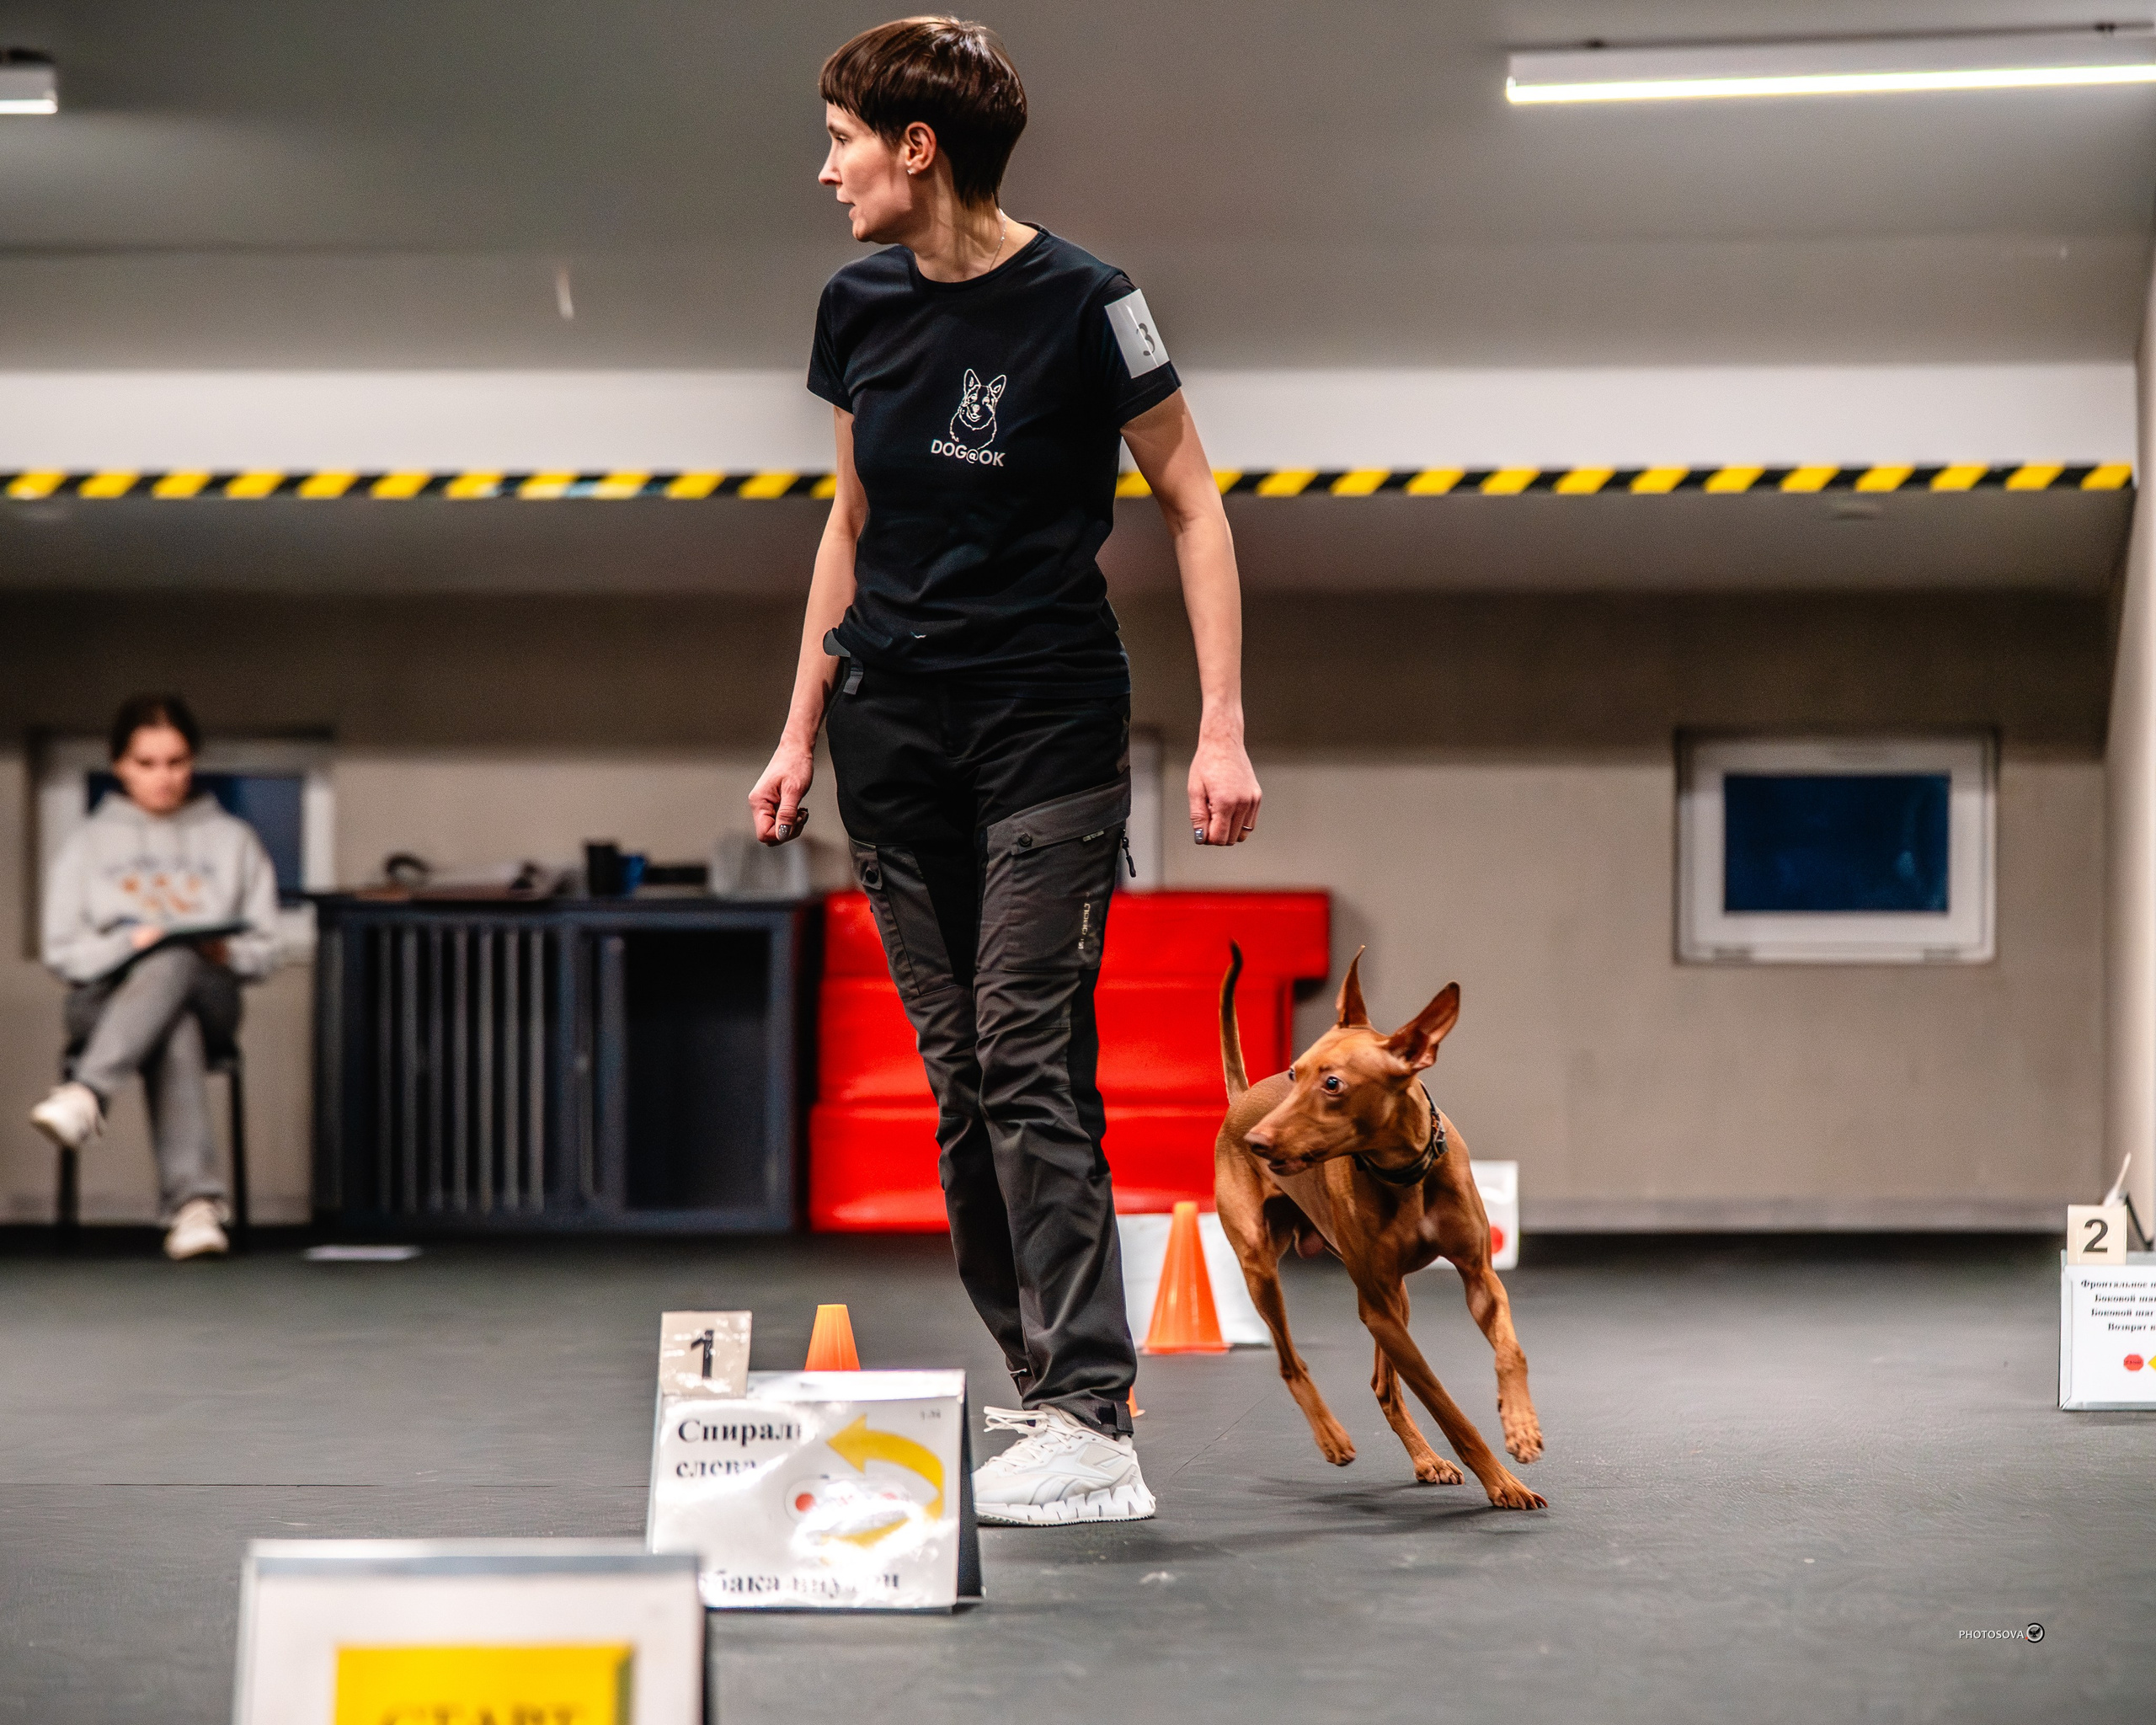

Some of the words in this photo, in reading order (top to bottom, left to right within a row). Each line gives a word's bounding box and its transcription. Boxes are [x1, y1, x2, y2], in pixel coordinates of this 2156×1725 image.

[931, 439, 1006, 467] DOG@OK
[2083, 1218, 2109, 1253] 2
[2090, 1308, 2132, 1317] Боковой
[690, 1330, 715, 1380] 1
